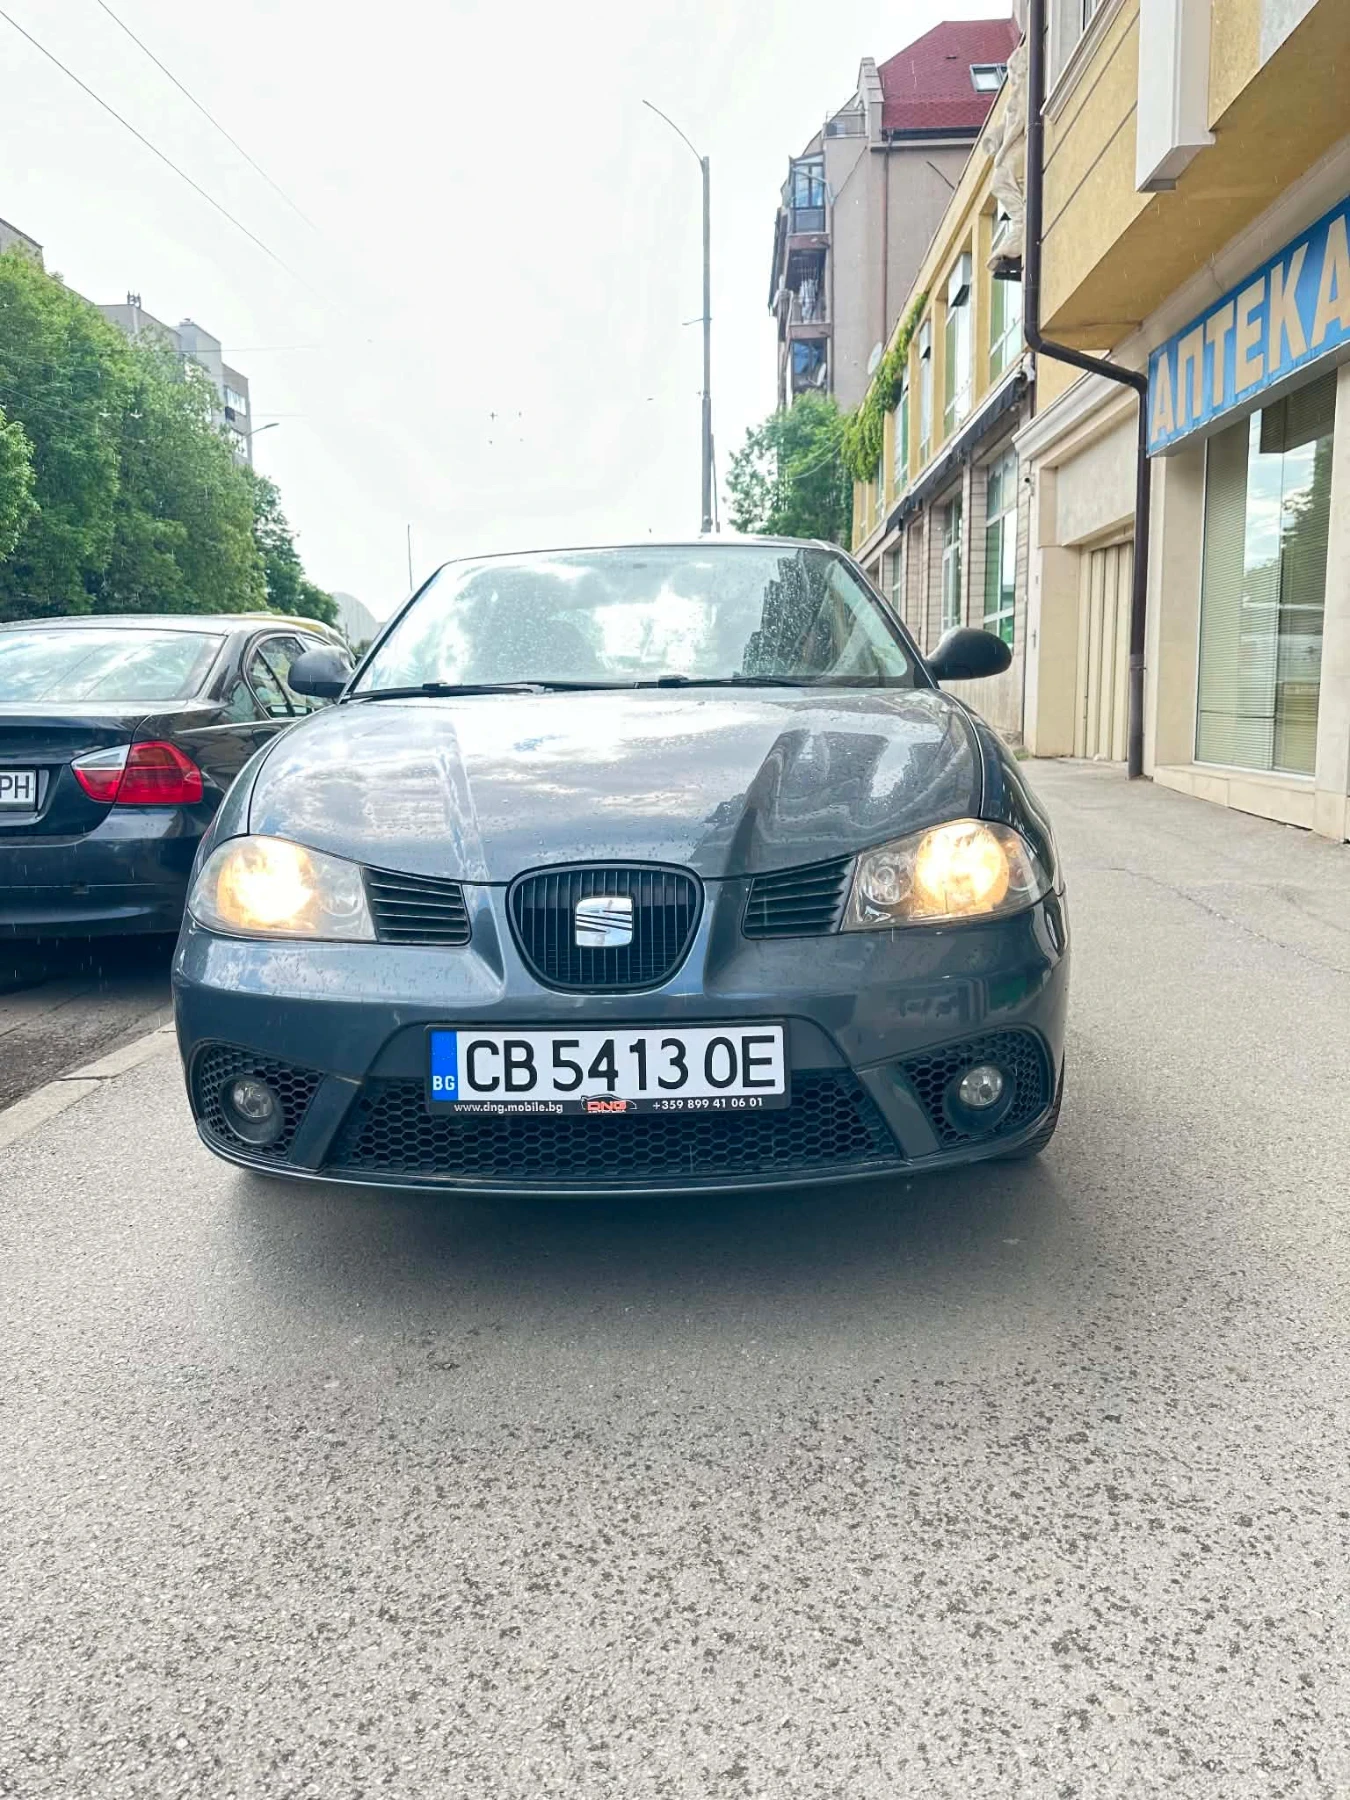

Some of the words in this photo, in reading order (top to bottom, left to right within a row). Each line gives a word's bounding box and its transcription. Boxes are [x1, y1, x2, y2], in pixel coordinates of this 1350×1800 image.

[1151, 214, 1350, 443] АПТЕКА
[466, 1040, 538, 1092] CB
[553, 1038, 689, 1091] 5413
[704, 1035, 776, 1088] OE
[432, 1075, 455, 1091] BG
[454, 1102, 563, 1114] www.dng.mobile.bg
[652, 1100, 683, 1110] +359
[687, 1099, 709, 1109] 899
[713, 1099, 729, 1109] 41
[732, 1098, 747, 1108] 06
[749, 1098, 763, 1108] 01
